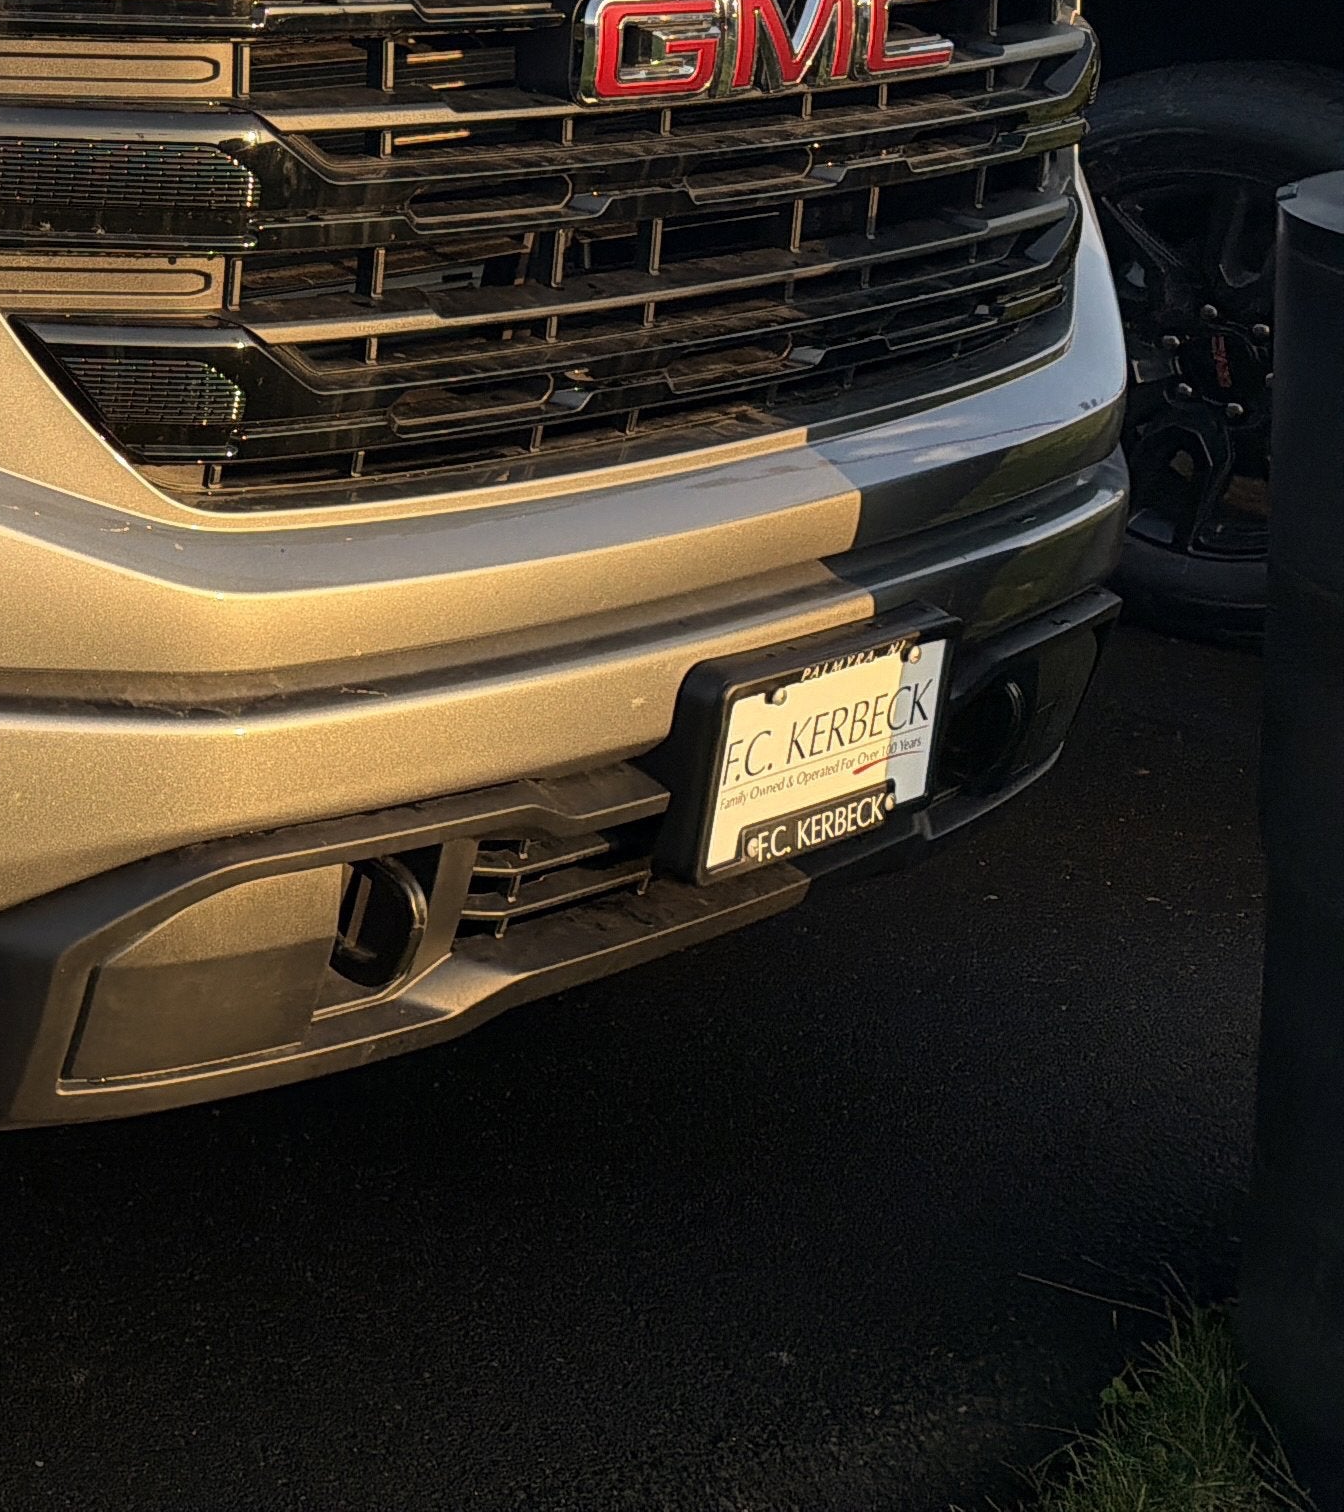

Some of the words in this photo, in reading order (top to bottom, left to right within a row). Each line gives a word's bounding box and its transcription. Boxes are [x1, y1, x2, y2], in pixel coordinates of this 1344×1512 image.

[723, 730, 772, 786] F.C.
[786, 678, 933, 765] KERBECK
[720, 792, 748, 811] Family
[749, 776, 784, 800] Owned
[796, 761, 840, 786] Operated
[840, 757, 856, 773] For
[857, 750, 880, 767] Over
[899, 737, 922, 753] Years
[755, 824, 792, 863] F.C.
[797, 792, 886, 850] KERBECK
